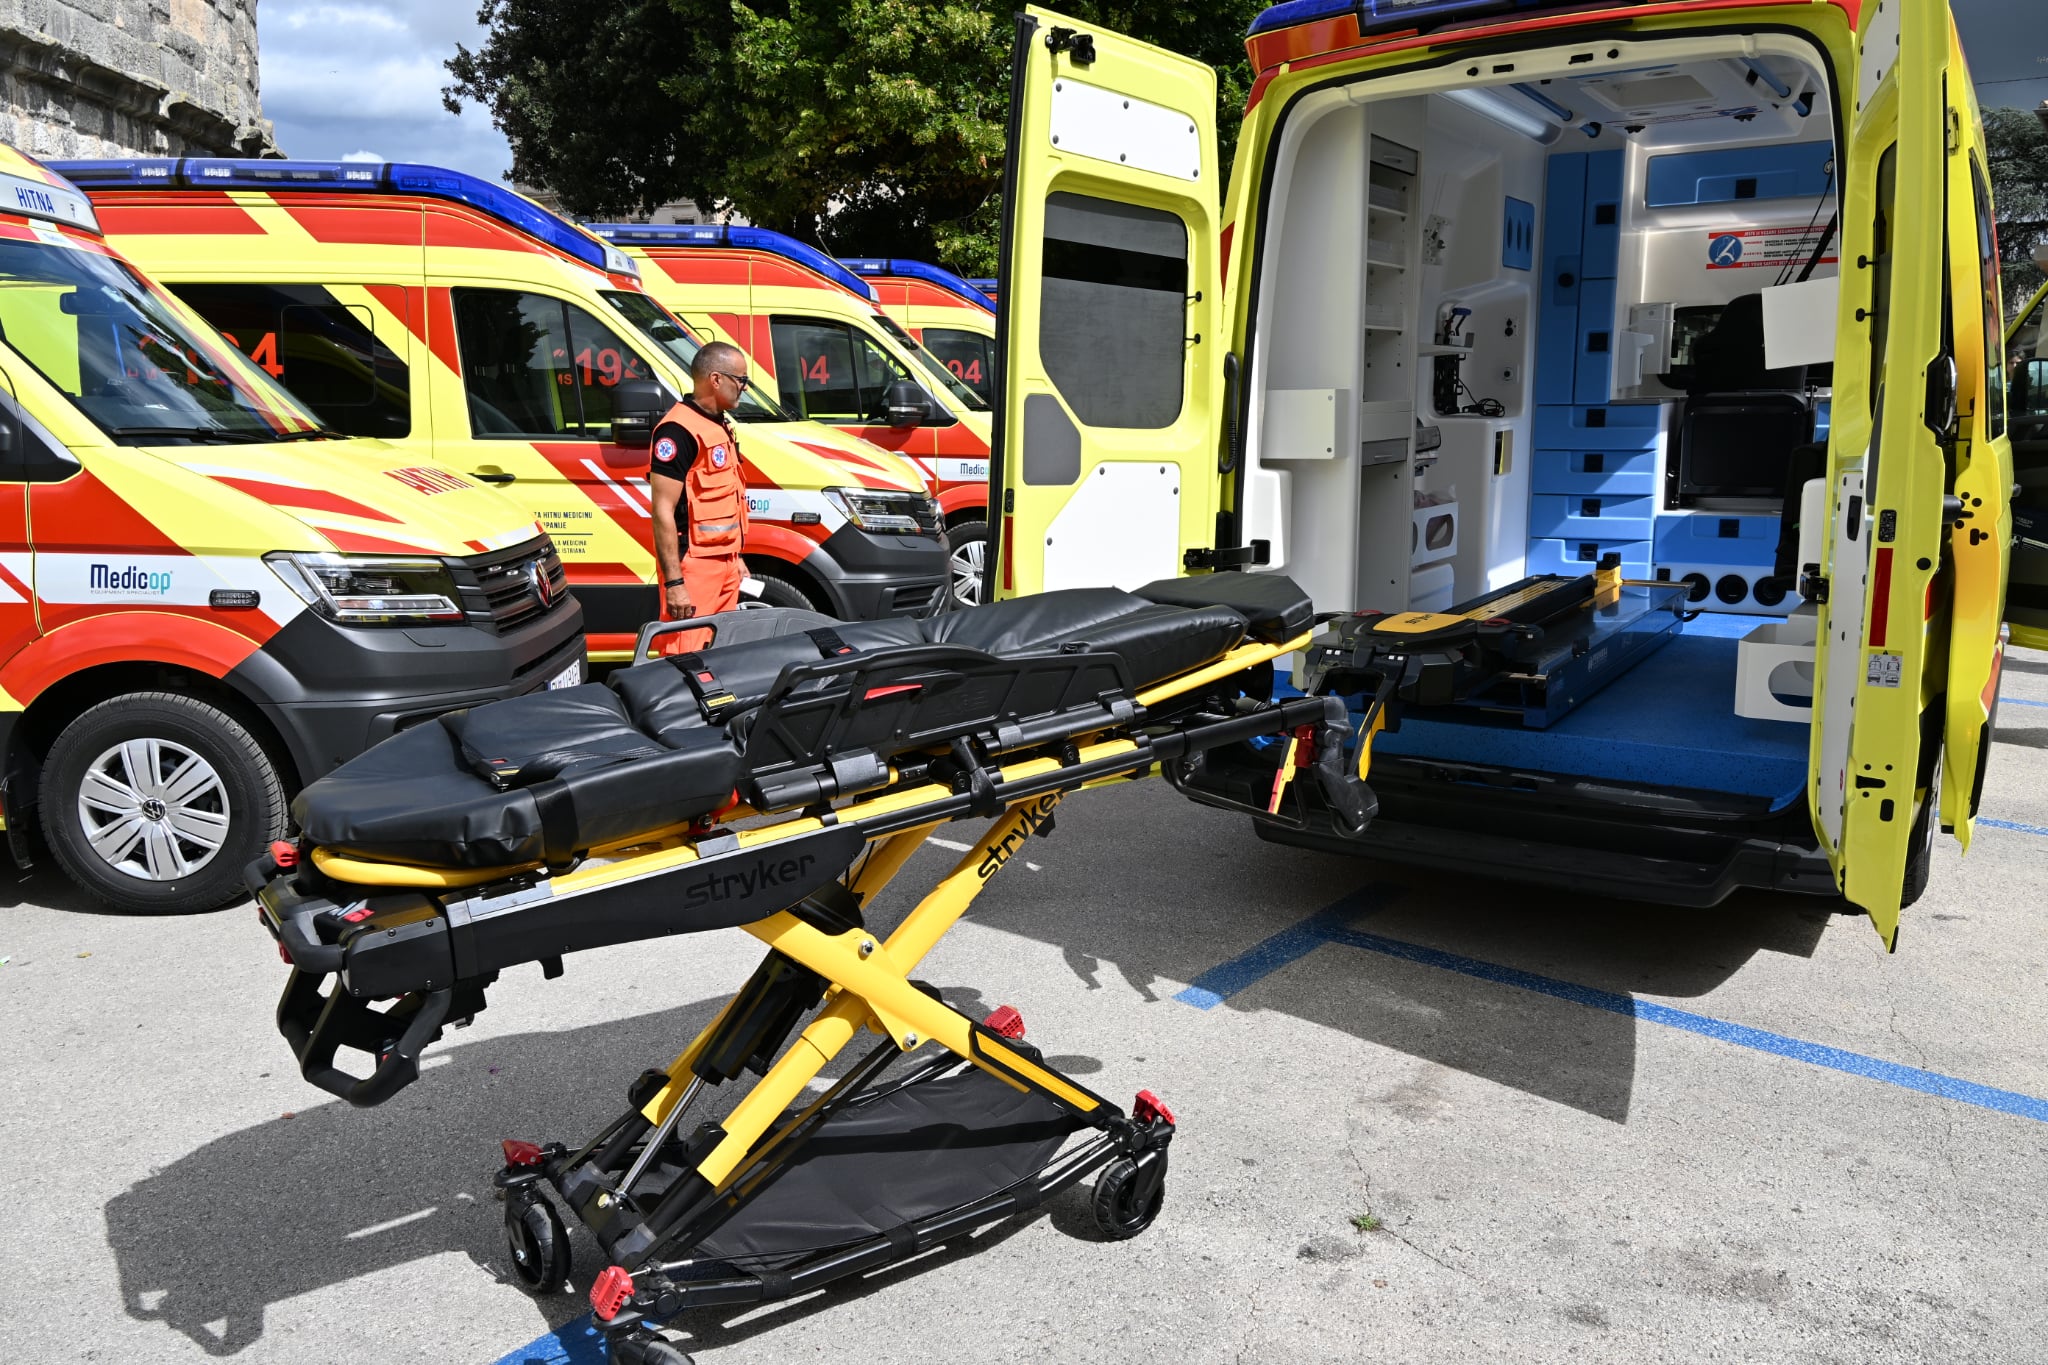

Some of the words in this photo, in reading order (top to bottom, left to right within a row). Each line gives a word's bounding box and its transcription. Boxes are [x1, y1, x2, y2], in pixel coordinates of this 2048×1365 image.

[15, 186, 55, 214] HITNA
[543, 511, 562, 519] HITNU
[563, 511, 593, 519] MEDICINU
[90, 564, 172, 595] Medicop
[684, 854, 816, 910] stryker
